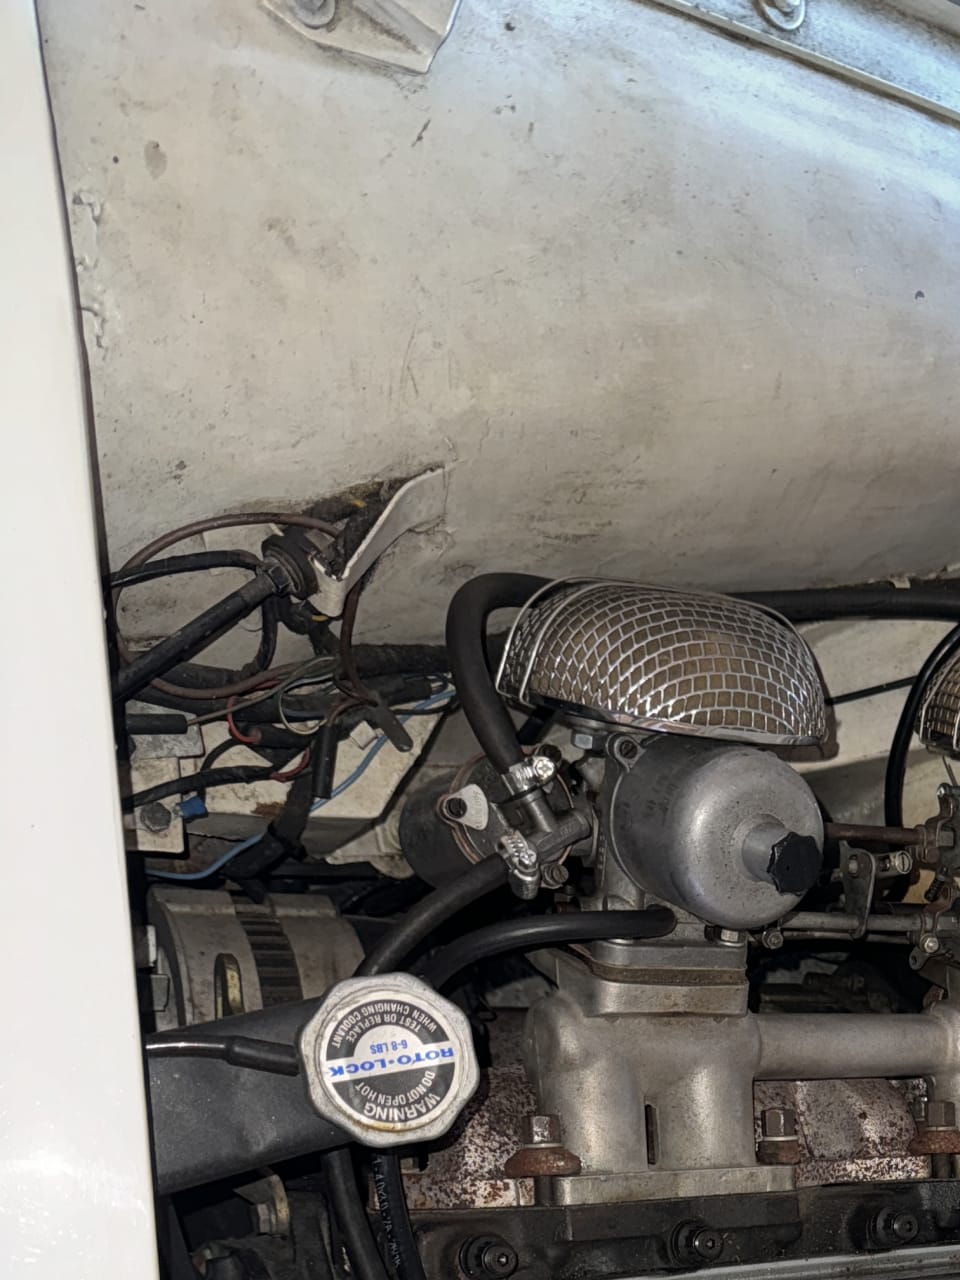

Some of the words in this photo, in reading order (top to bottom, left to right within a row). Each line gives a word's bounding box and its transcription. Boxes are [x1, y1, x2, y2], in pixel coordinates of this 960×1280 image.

[361, 1001, 410, 1015] CHANGING
[384, 1014, 397, 1023] OR
[400, 1015, 421, 1033] TEST
[412, 1011, 438, 1033] WHEN
[331, 1010, 361, 1050] COOLANT
[346, 1014, 382, 1043] REPLACE
[370, 1042, 389, 1055] LBS
[391, 1039, 408, 1052] 6-8
[423, 1070, 436, 1088] DO
[355, 1081, 376, 1100] HOT
[377, 1092, 407, 1106] OPEN
[408, 1086, 427, 1103] NOT
[363, 1095, 440, 1122] WARNING
